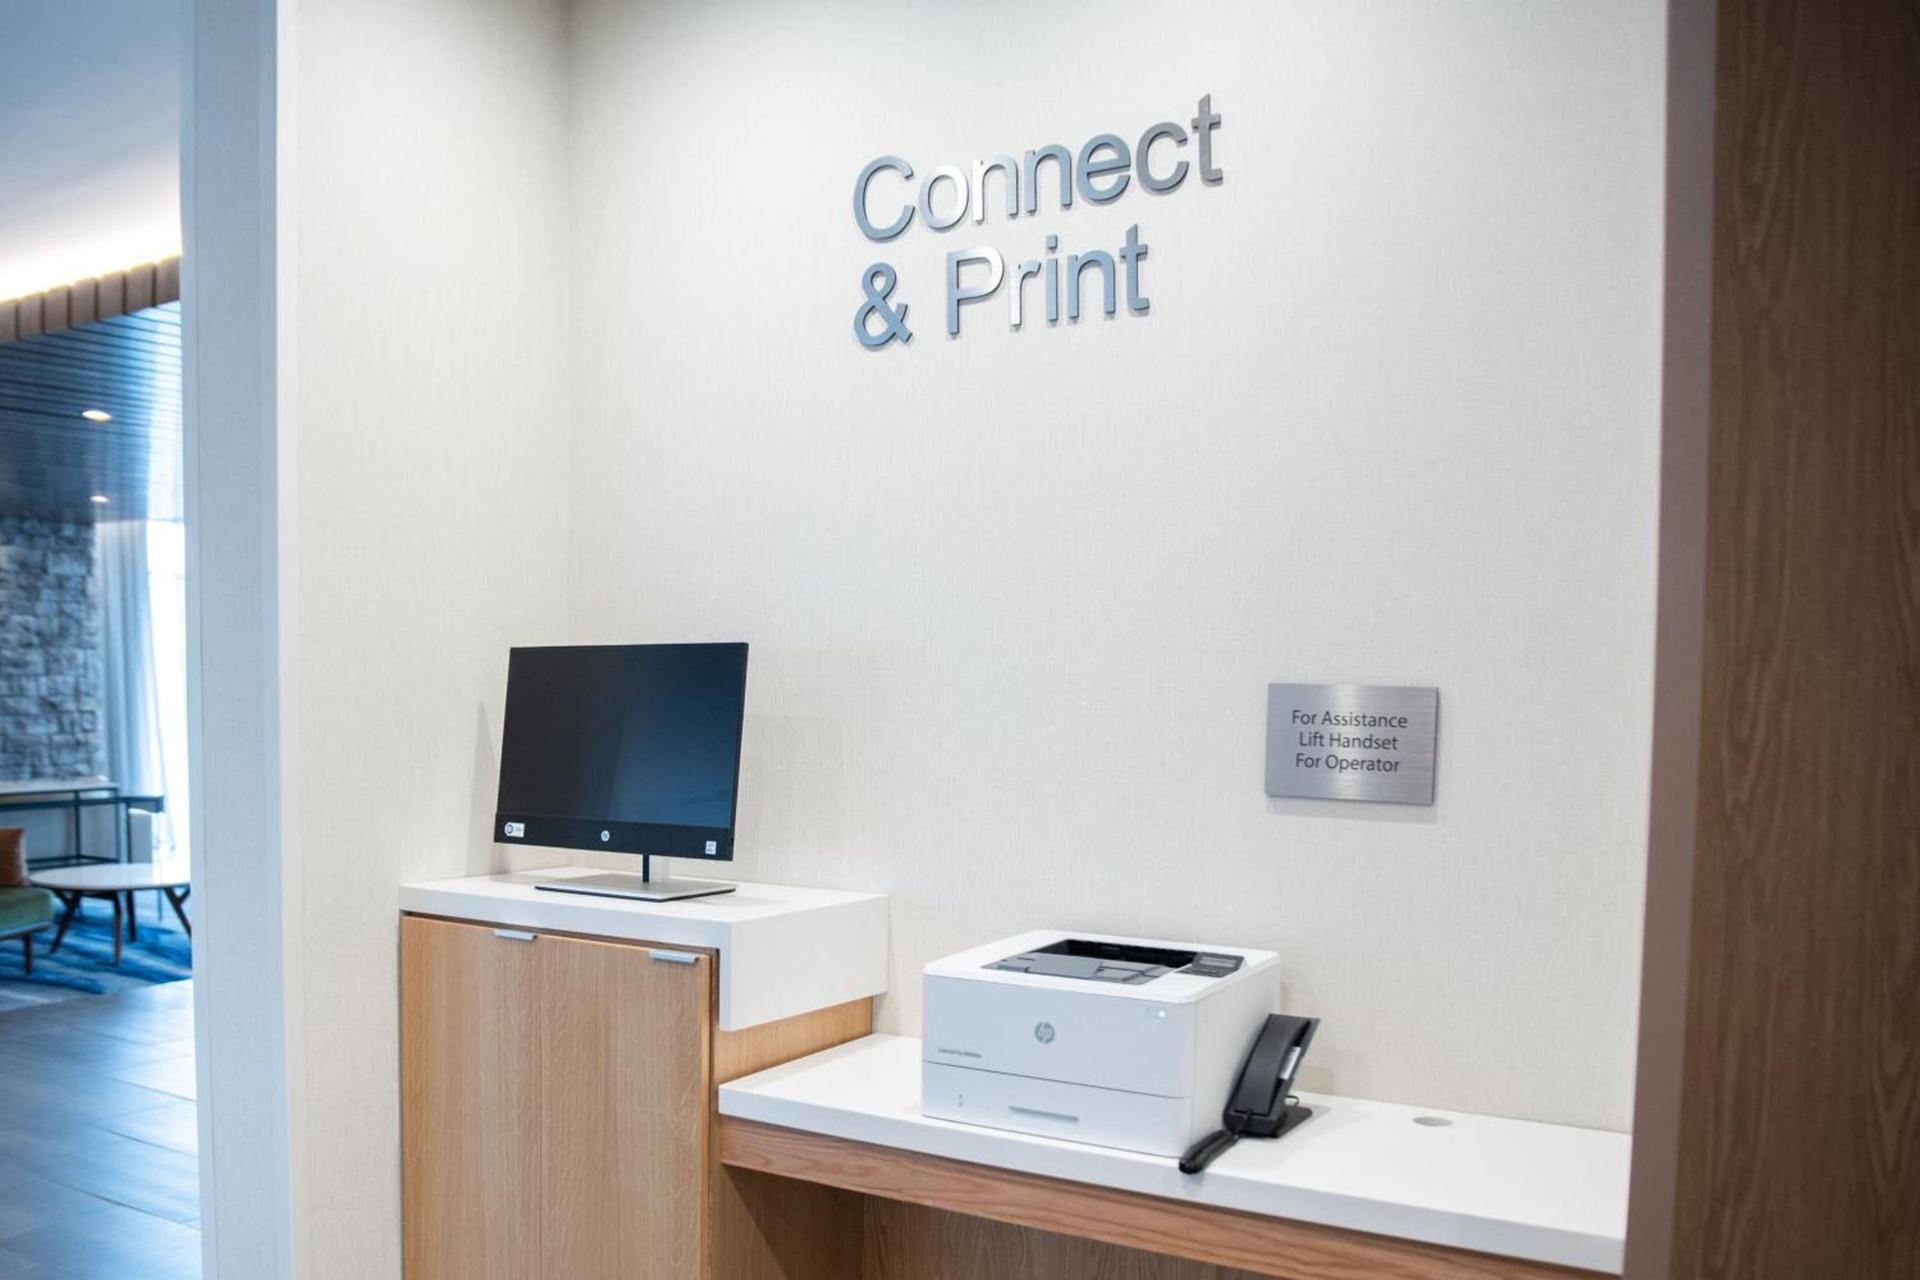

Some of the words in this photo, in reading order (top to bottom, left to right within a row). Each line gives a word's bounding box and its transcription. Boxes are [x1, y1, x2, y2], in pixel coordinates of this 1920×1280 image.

[853, 93, 1223, 242] Connect
[853, 262, 913, 348] &
[946, 223, 1150, 336] Print
[1291, 709, 1317, 725] For
[1321, 711, 1408, 729] Assistance
[1299, 731, 1325, 748] Lift
[1329, 733, 1399, 751] Handset
[1295, 753, 1321, 769] For
[1325, 754, 1401, 773] Operator
